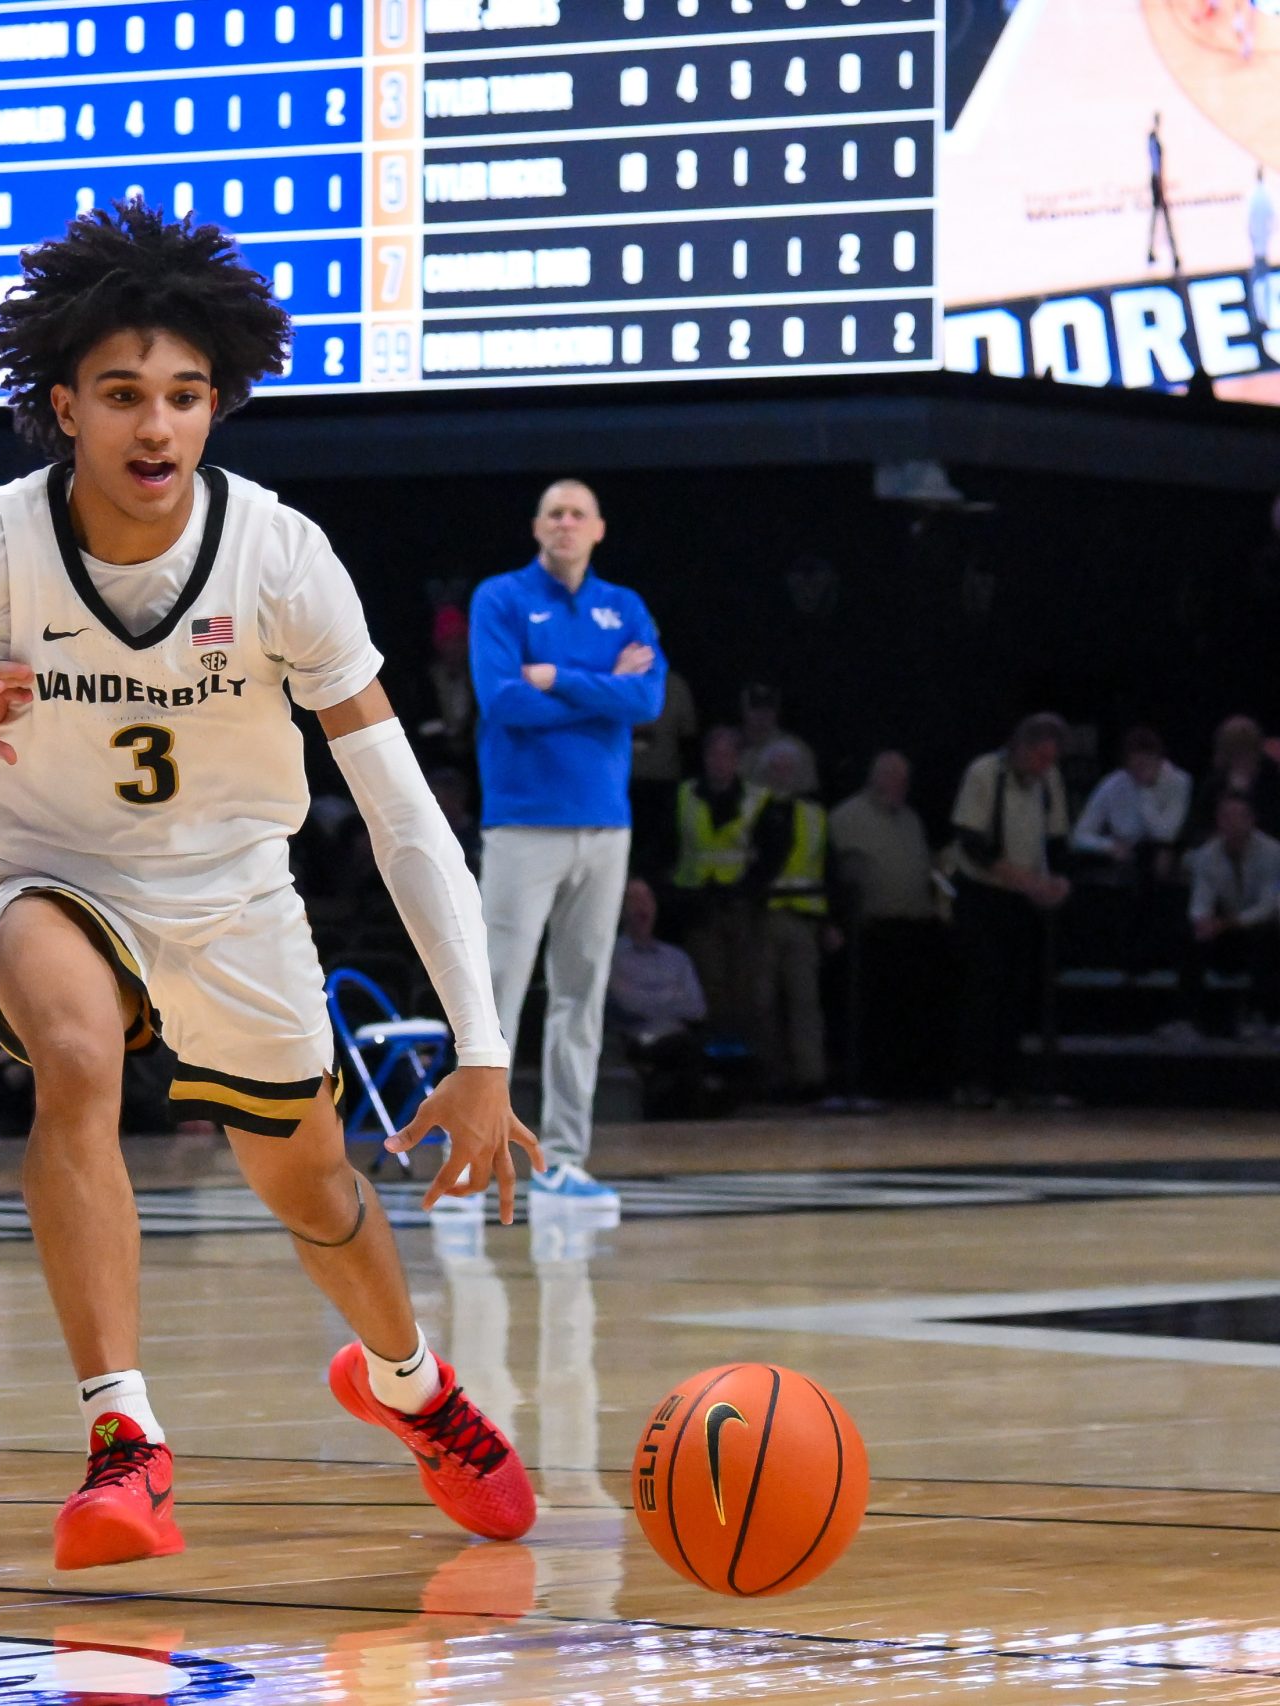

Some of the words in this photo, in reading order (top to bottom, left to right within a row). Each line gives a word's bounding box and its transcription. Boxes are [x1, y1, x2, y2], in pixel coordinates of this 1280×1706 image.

[330, 4, 342, 39] 1
[76, 104, 95, 139] 4
[125, 101, 144, 136] 4
[228, 96, 241, 130] 1
[279, 93, 291, 128] 1
[326, 88, 345, 126] 2
[380, 71, 407, 129] 3
[676, 63, 698, 103] 4
[784, 56, 807, 97] 4
[898, 50, 913, 90] 1
[329, 175, 341, 210] 1
[379, 155, 407, 213] 5
[733, 147, 748, 187] 1
[784, 143, 806, 184] 2
[842, 141, 858, 181] 1
[328, 261, 341, 297] 1
[379, 245, 407, 303] 7
[678, 243, 694, 282] 1
[732, 240, 748, 279] 1
[787, 237, 802, 277] 1
[838, 233, 861, 275] 2
[324, 337, 344, 376] 2
[373, 329, 412, 376] 99
[728, 319, 751, 360] 2
[841, 316, 857, 356] 1
[893, 312, 916, 354] 2
[201, 652, 227, 671] SEC
[36, 670, 247, 709] VANDERBILT
[110, 723, 180, 805] 3
[639, 1395, 686, 1512] ELITE
